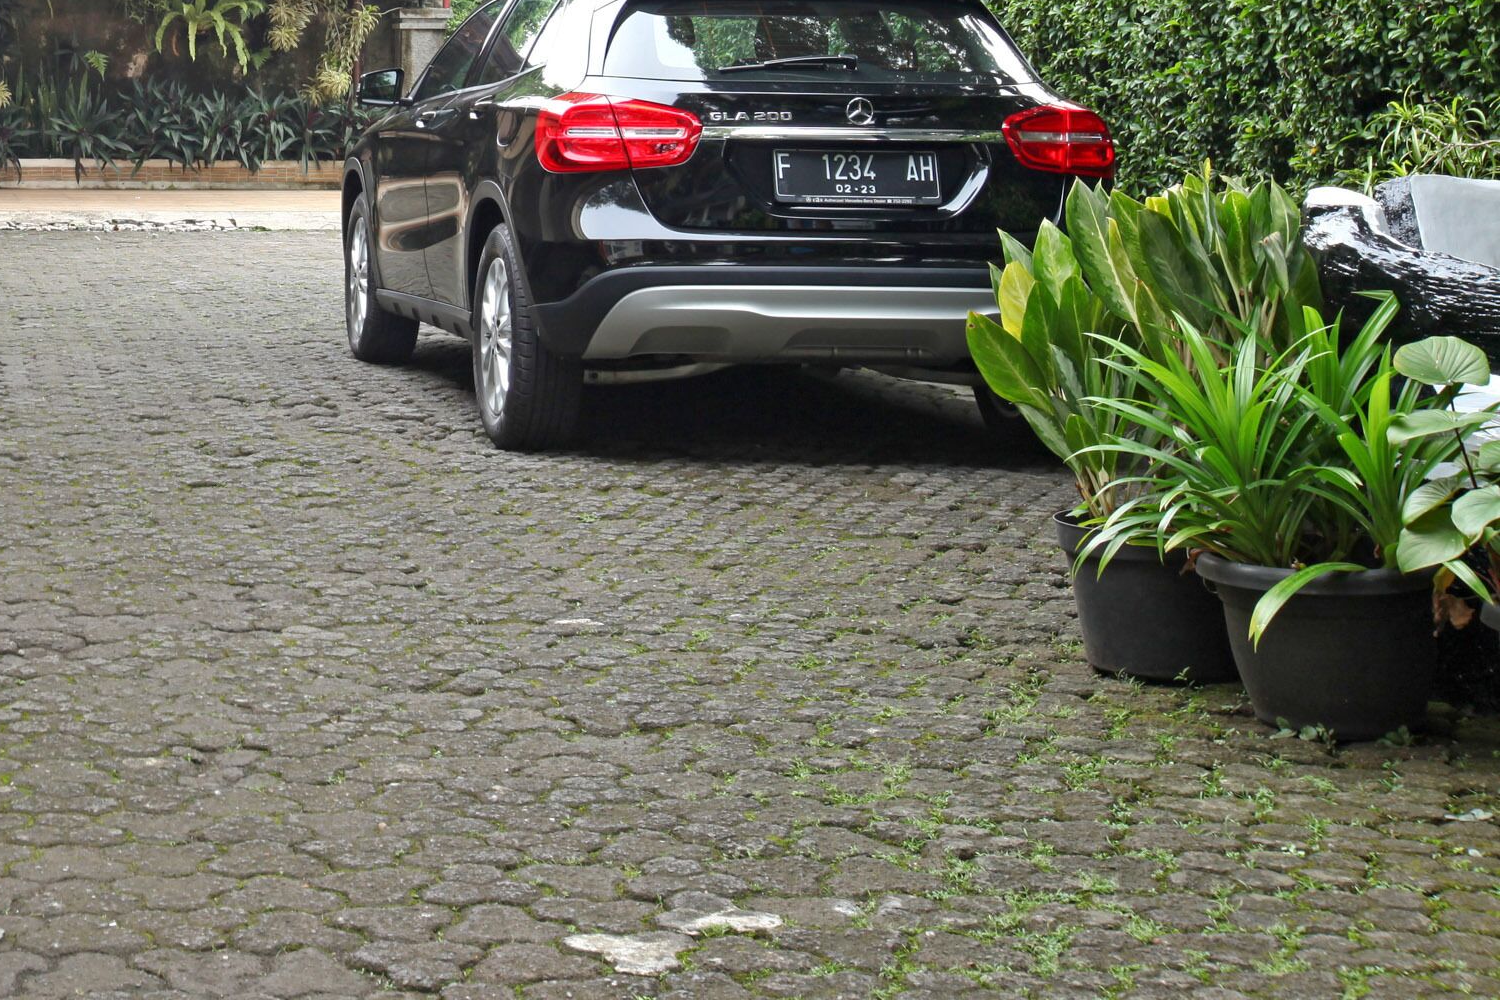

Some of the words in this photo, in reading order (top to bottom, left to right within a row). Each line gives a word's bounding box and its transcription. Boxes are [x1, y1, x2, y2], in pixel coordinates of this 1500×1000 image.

[709, 111, 750, 121] GLA
[754, 111, 793, 121] 200
[777, 153, 791, 179] F
[821, 154, 876, 181] 1234
[906, 154, 934, 182] AH
